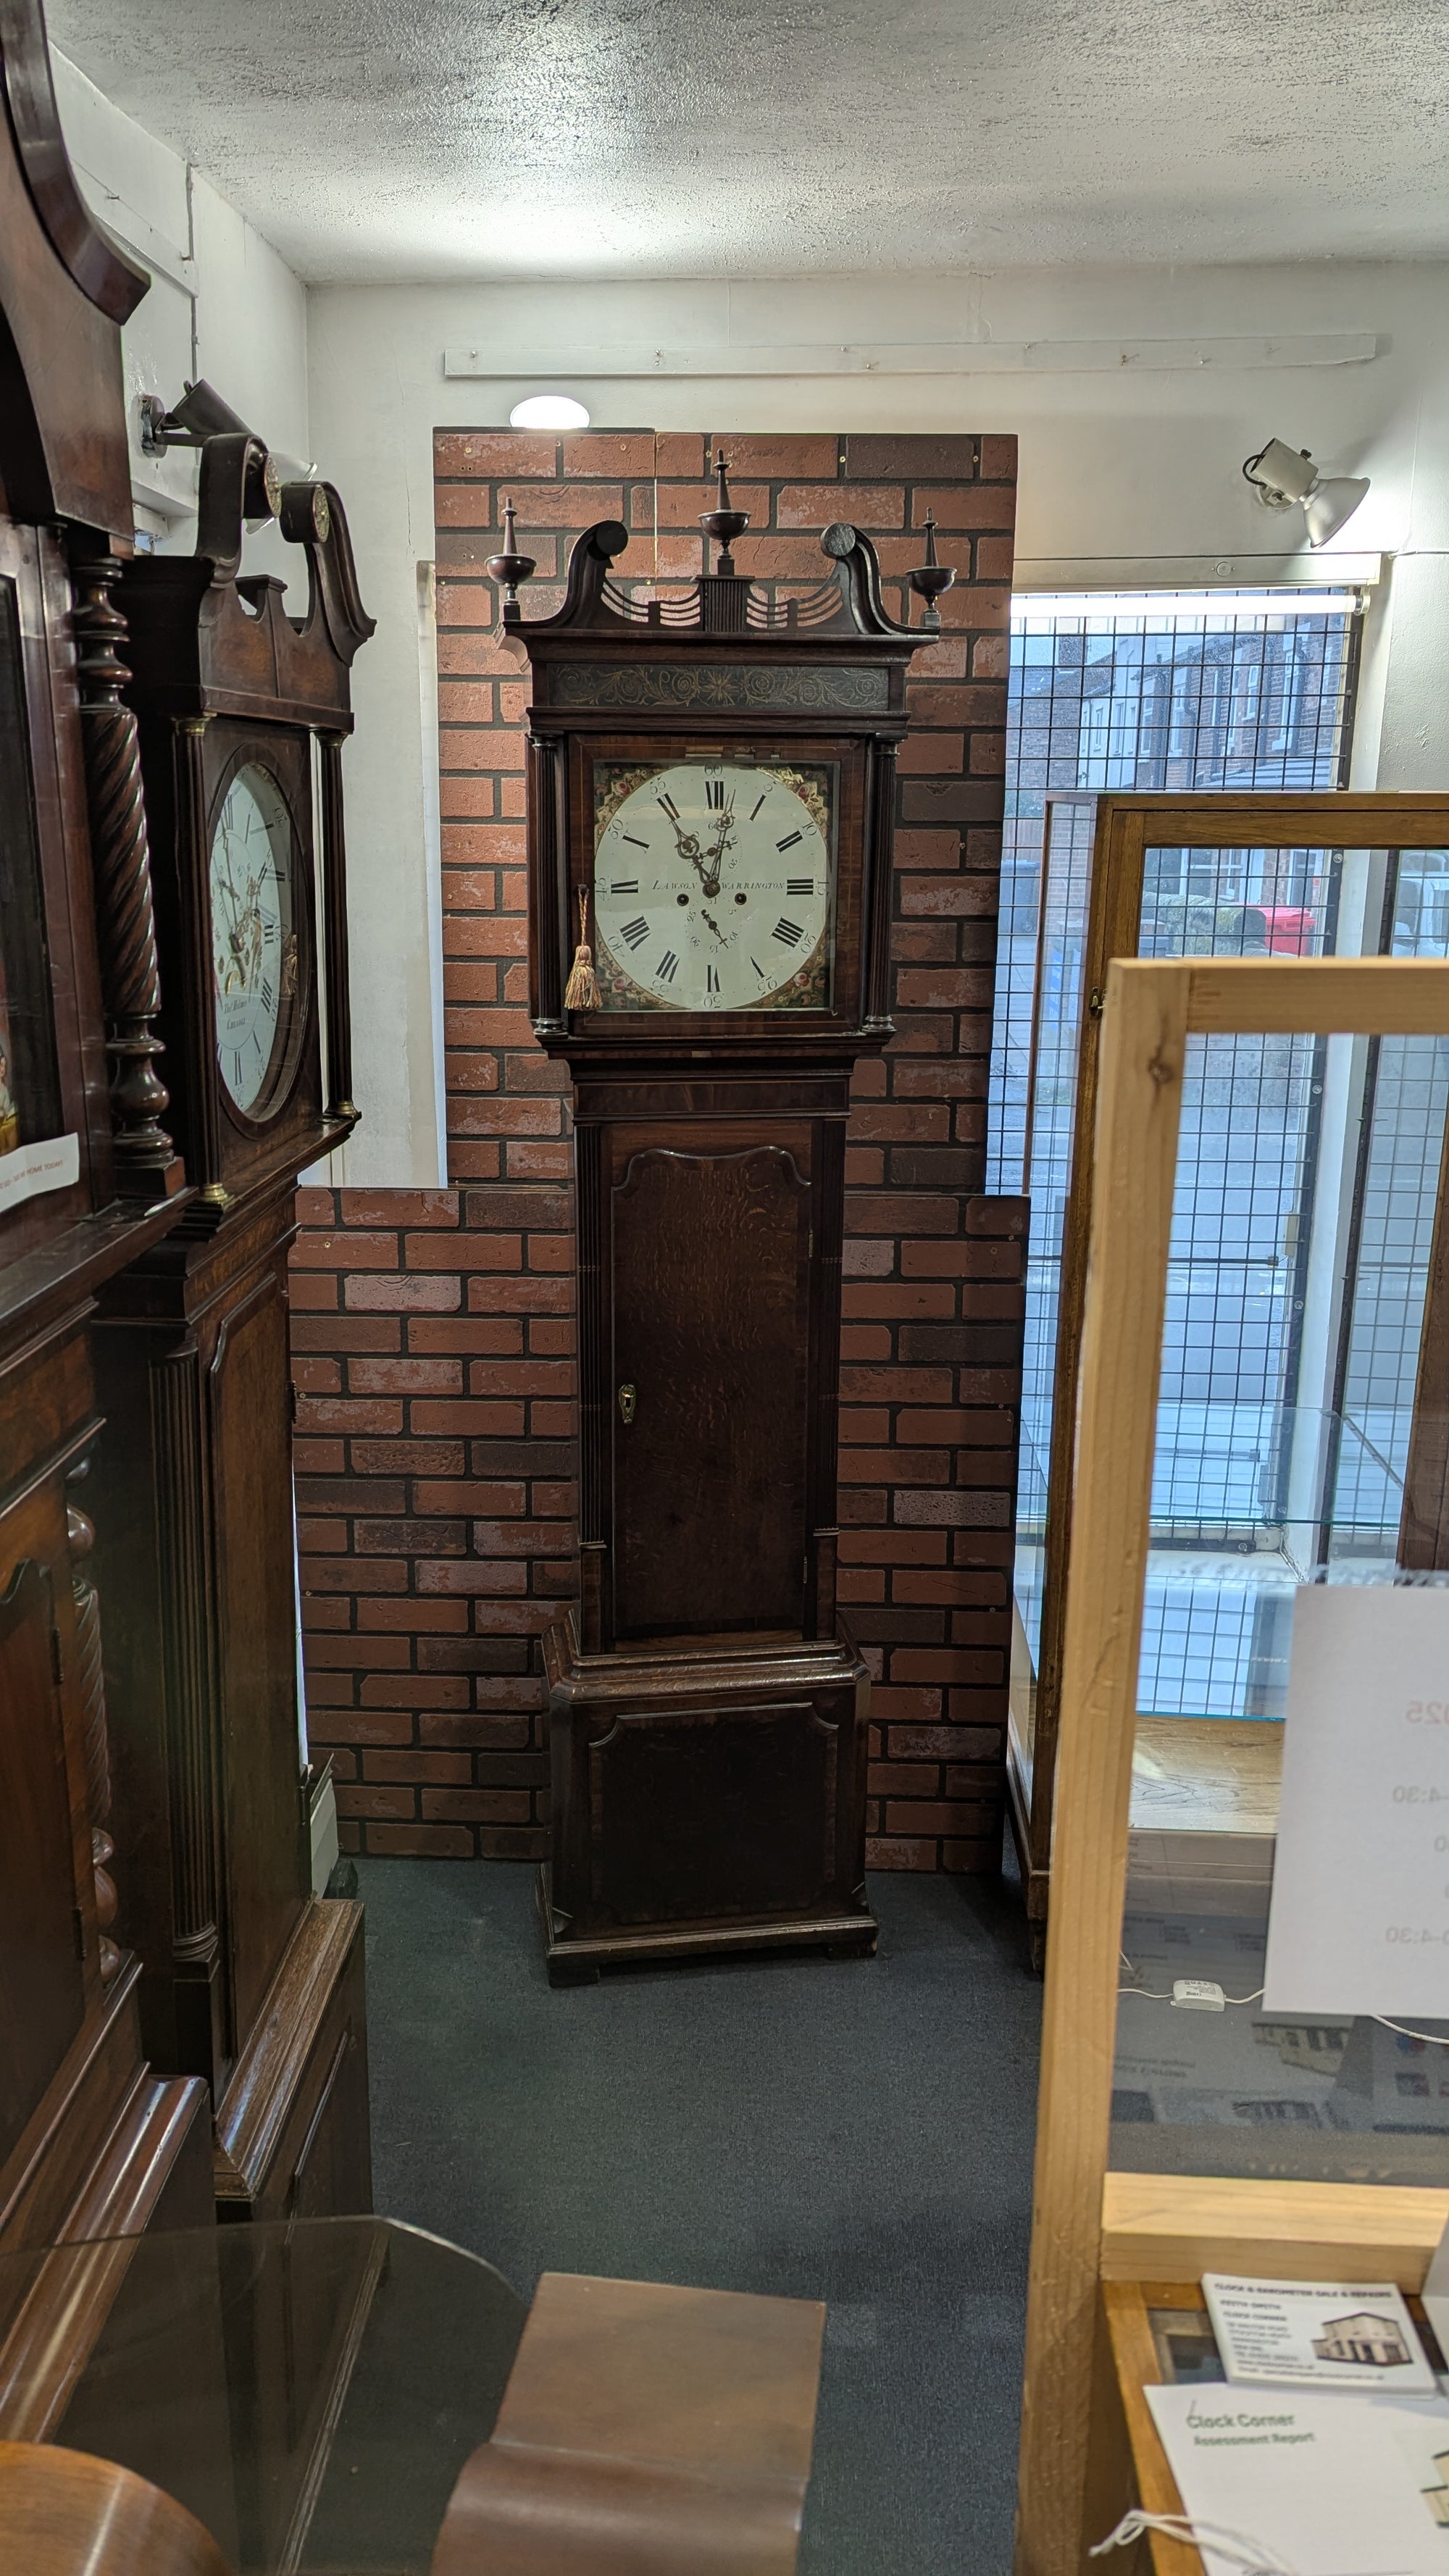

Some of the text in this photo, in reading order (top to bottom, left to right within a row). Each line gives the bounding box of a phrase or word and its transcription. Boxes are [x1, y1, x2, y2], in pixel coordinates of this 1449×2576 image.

[704, 764, 723, 777] 60
[650, 775, 667, 795] 55
[704, 781, 724, 811] XII
[607, 818, 624, 840] 50
[801, 820, 818, 836] 10
[596, 877, 607, 901] 45
[653, 879, 698, 890] LAWSON
[786, 878, 814, 896] III
[608, 935, 625, 958] 40
[799, 932, 817, 954] 20
[1187, 2414, 1295, 2428] Clock Corner
[1195, 2432, 1314, 2446] Assessment Report
